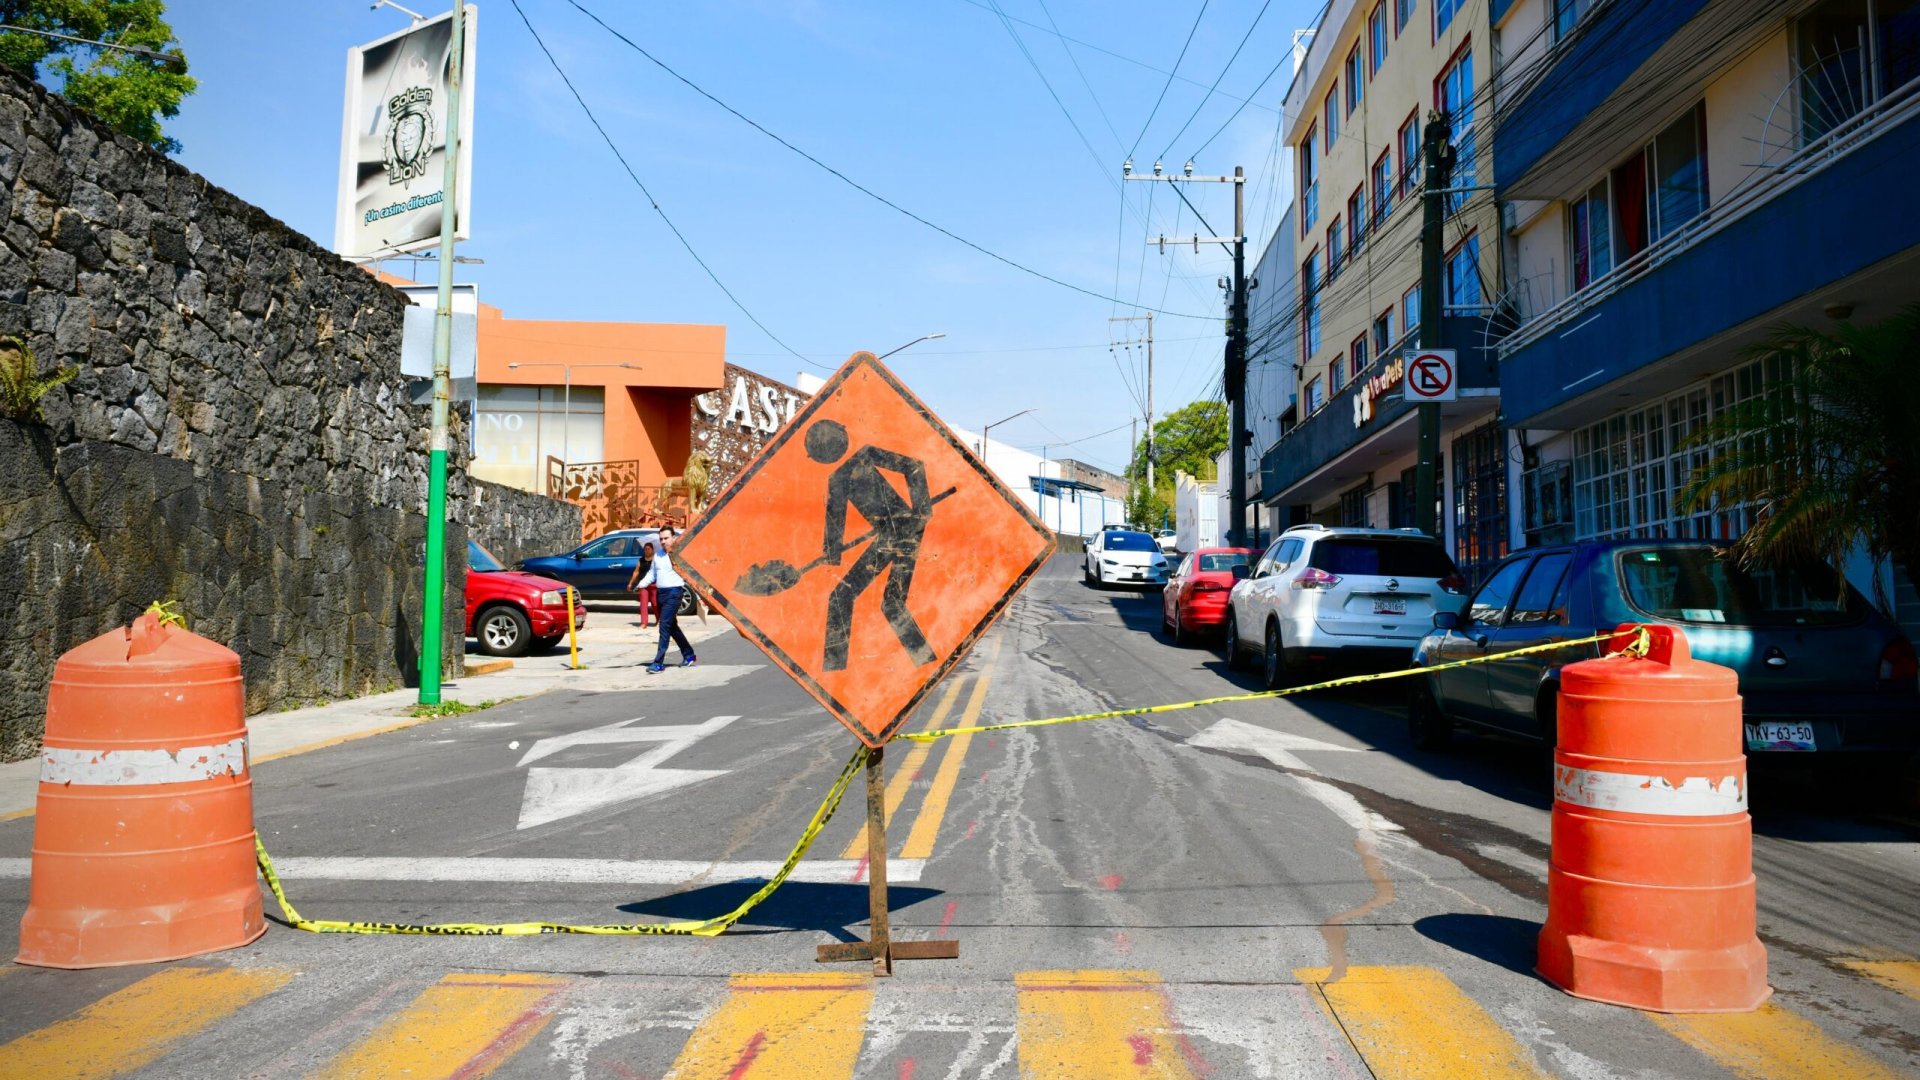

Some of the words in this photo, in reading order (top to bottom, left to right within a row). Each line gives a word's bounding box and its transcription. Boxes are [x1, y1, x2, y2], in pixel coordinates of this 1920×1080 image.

[388, 86, 432, 113] Golden
[379, 202, 407, 219] casino
[1747, 726, 1812, 741] YKV-63-50
